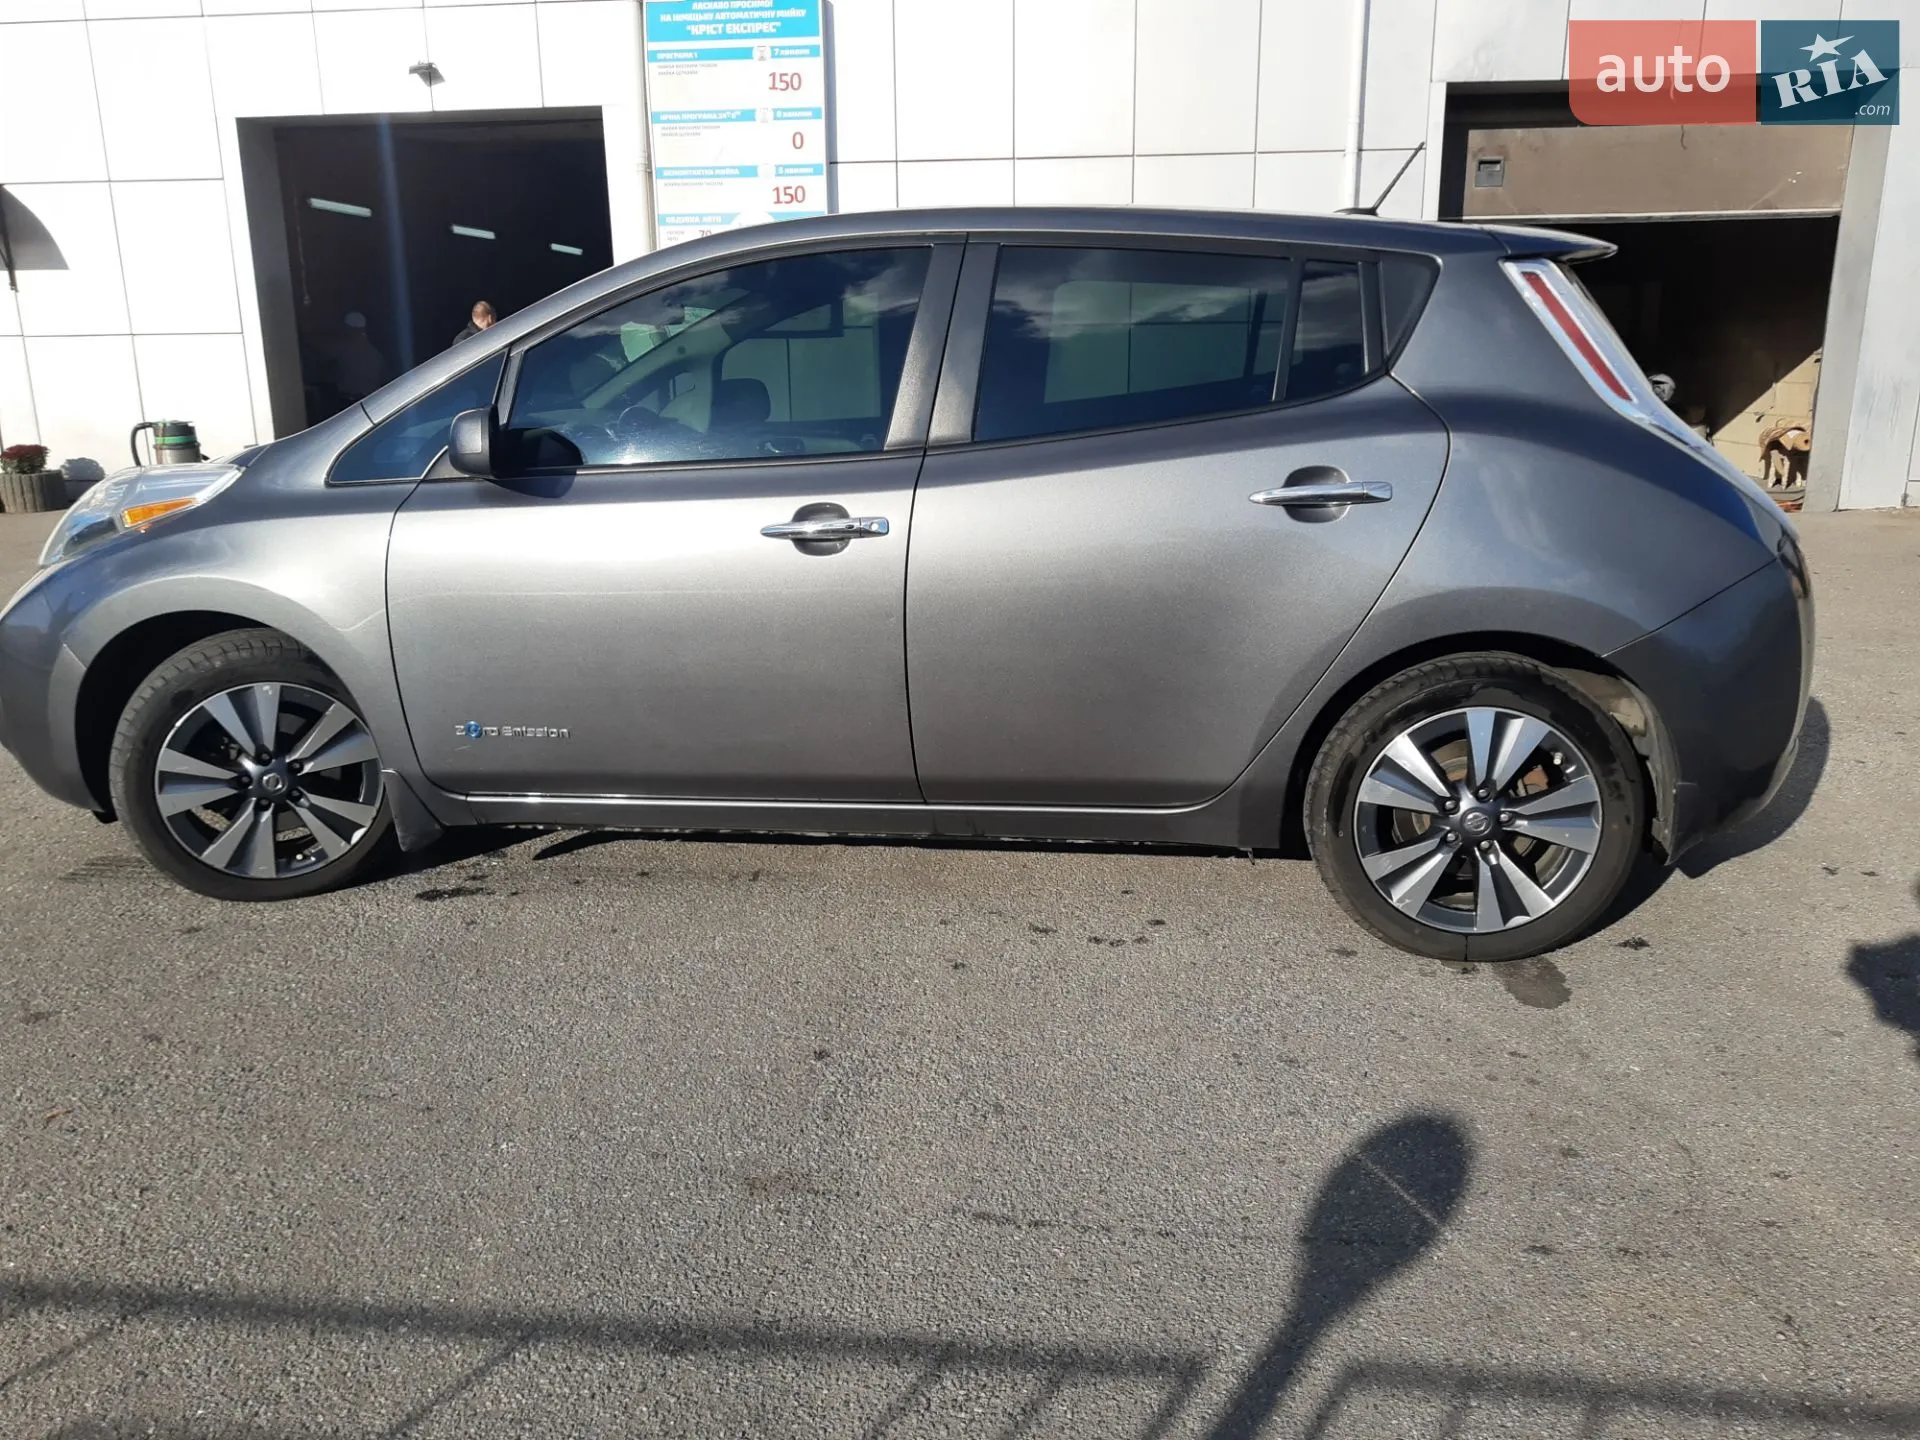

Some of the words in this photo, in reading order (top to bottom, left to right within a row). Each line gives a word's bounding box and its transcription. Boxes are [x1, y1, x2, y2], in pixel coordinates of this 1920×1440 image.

[768, 71, 802, 91] 150
[792, 131, 804, 149] 0
[772, 185, 806, 204] 150
[502, 725, 571, 739] Emission
